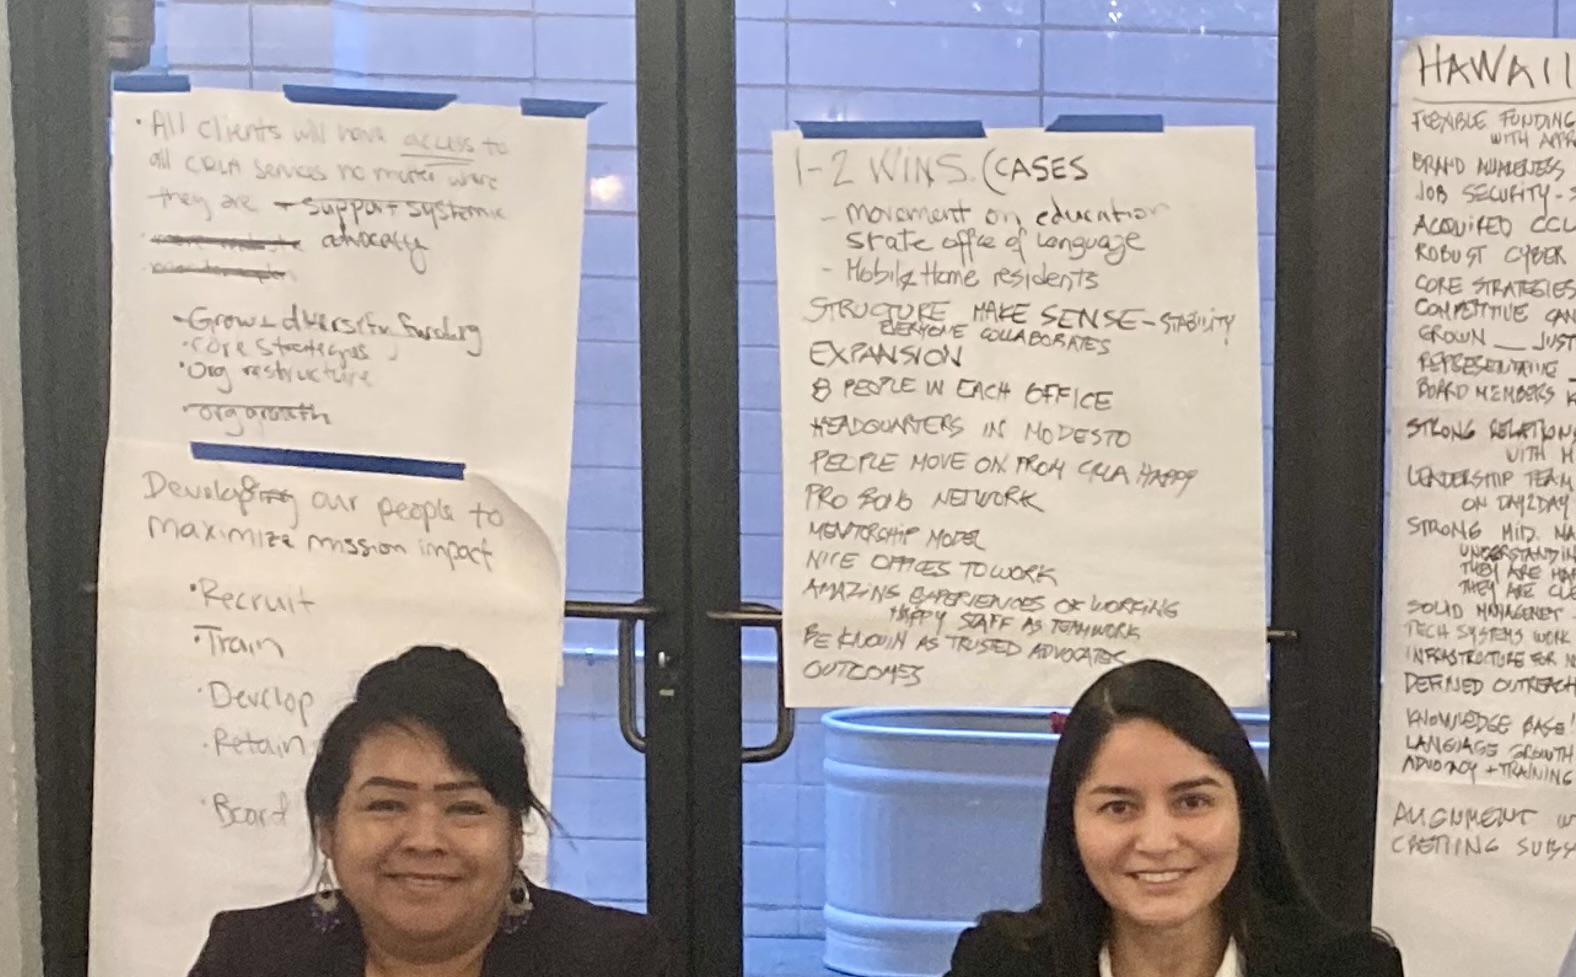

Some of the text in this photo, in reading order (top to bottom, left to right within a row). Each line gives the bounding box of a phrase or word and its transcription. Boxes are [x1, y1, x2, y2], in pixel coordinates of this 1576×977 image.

[1416, 184, 1447, 203] JOB
[810, 341, 963, 367] EXPANSION
[843, 377, 916, 397] PEOPLE
[926, 379, 944, 395] IN
[957, 378, 1011, 398] EACH
[1026, 382, 1113, 412] OFFICE
[983, 421, 1004, 439] IN
[1025, 423, 1131, 448] MODESTO
[811, 453, 899, 474] PEOPLE
[911, 454, 966, 472] MOVE
[975, 455, 1006, 474] ON
[932, 490, 1045, 512] NETWORK
[469, 502, 502, 527] to
